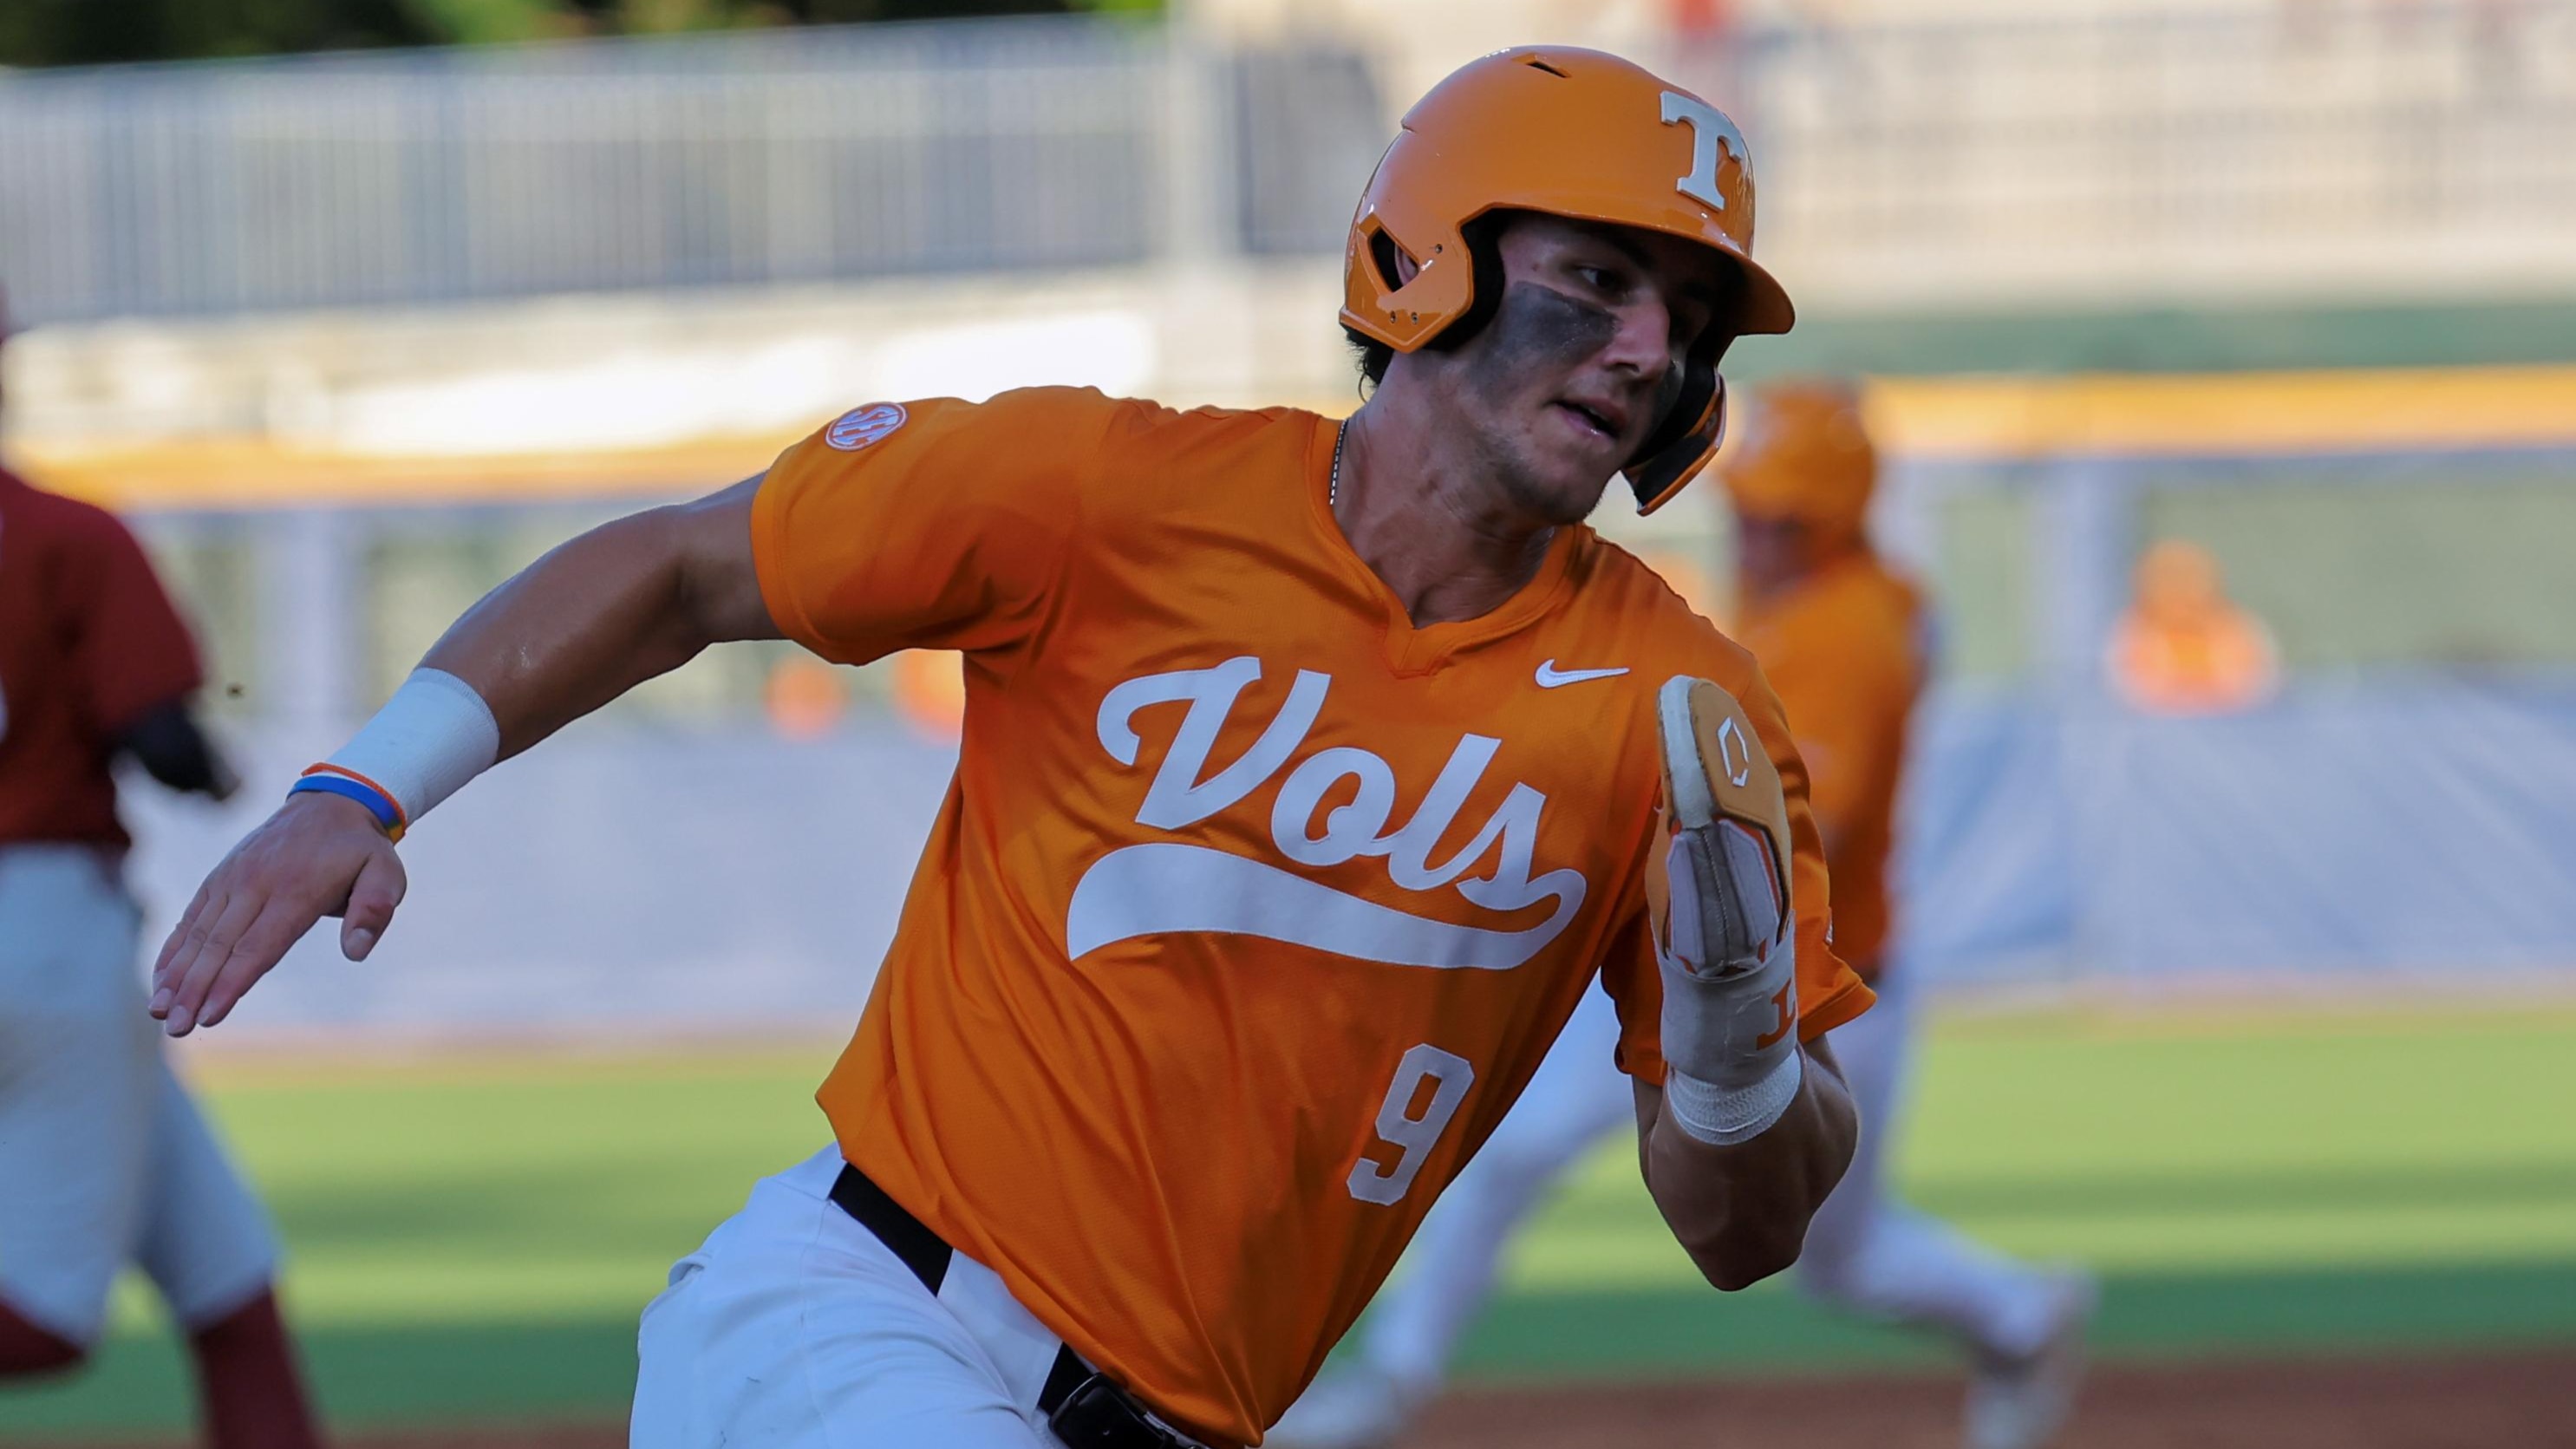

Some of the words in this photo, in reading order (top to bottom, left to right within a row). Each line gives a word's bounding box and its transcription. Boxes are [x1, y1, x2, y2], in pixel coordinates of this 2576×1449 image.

[1660, 90, 1745, 212] T
[831, 405, 902, 447] SEC
[1096, 656, 1588, 912] Vols
[1346, 1042, 1476, 1207] 9
